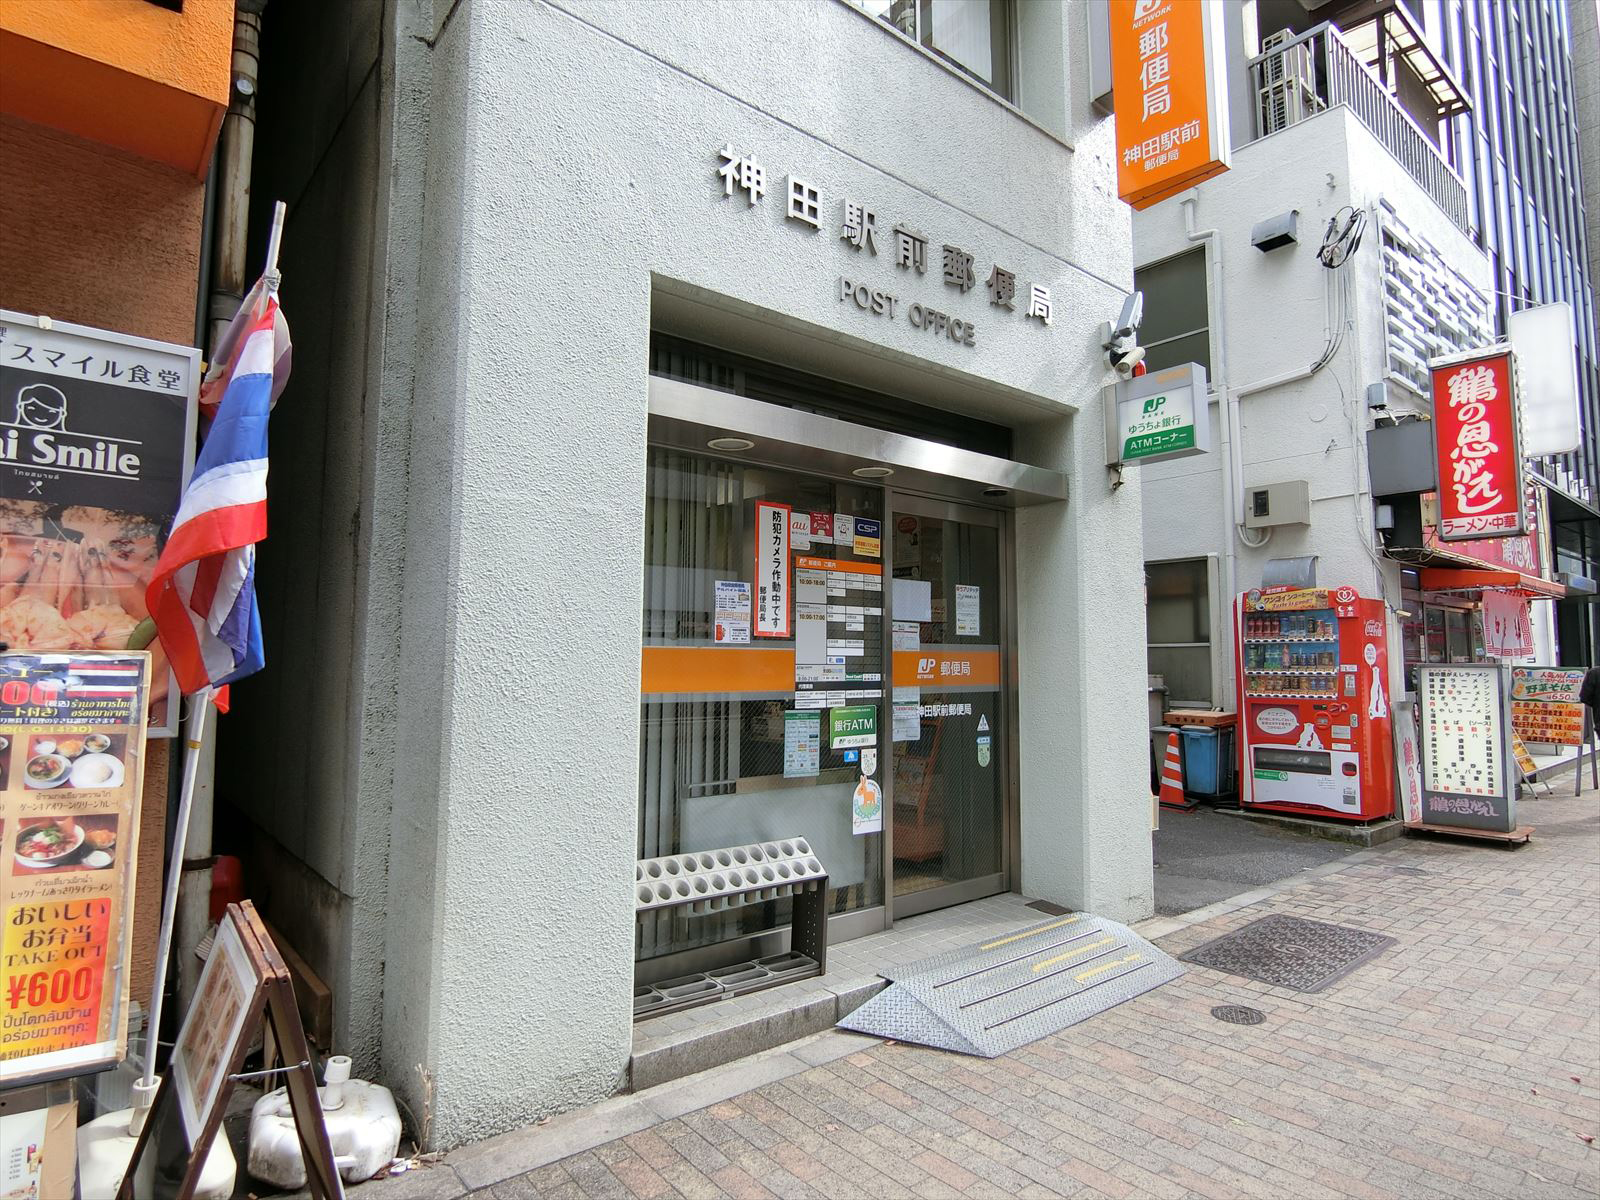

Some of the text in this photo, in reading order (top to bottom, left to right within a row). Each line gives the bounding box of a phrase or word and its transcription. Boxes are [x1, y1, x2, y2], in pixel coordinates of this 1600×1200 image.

[1132, 4, 1172, 30] NETWORK
[1139, 21, 1172, 123] 郵便局
[1123, 119, 1201, 167] 神田駅前
[1144, 150, 1180, 173] 郵便局
[717, 142, 1053, 326] 神田駅前郵便局
[839, 275, 977, 348] POST OFFICE
[1128, 414, 1182, 435] ゆうちょ銀行
[1129, 432, 1188, 451] ATMコーナー
[1446, 364, 1502, 515] 鶴の恩がえし
[31, 433, 140, 476] Smile
[791, 519, 808, 531] au
[857, 523, 878, 534] CSP
[1443, 514, 1518, 536] ラーメン・中華
[770, 509, 783, 631] 防犯カメラ作動中です
[759, 586, 768, 624] 郵便局長
[940, 661, 972, 677] 郵便局
[917, 703, 973, 718] 神田駅前郵便局
[834, 718, 874, 732] 銀行ATM
[12, 902, 106, 927] おいしい
[22, 924, 92, 949] お弁当
[5, 944, 103, 968] TAKE OUT
[5, 966, 93, 1010] ¥600
